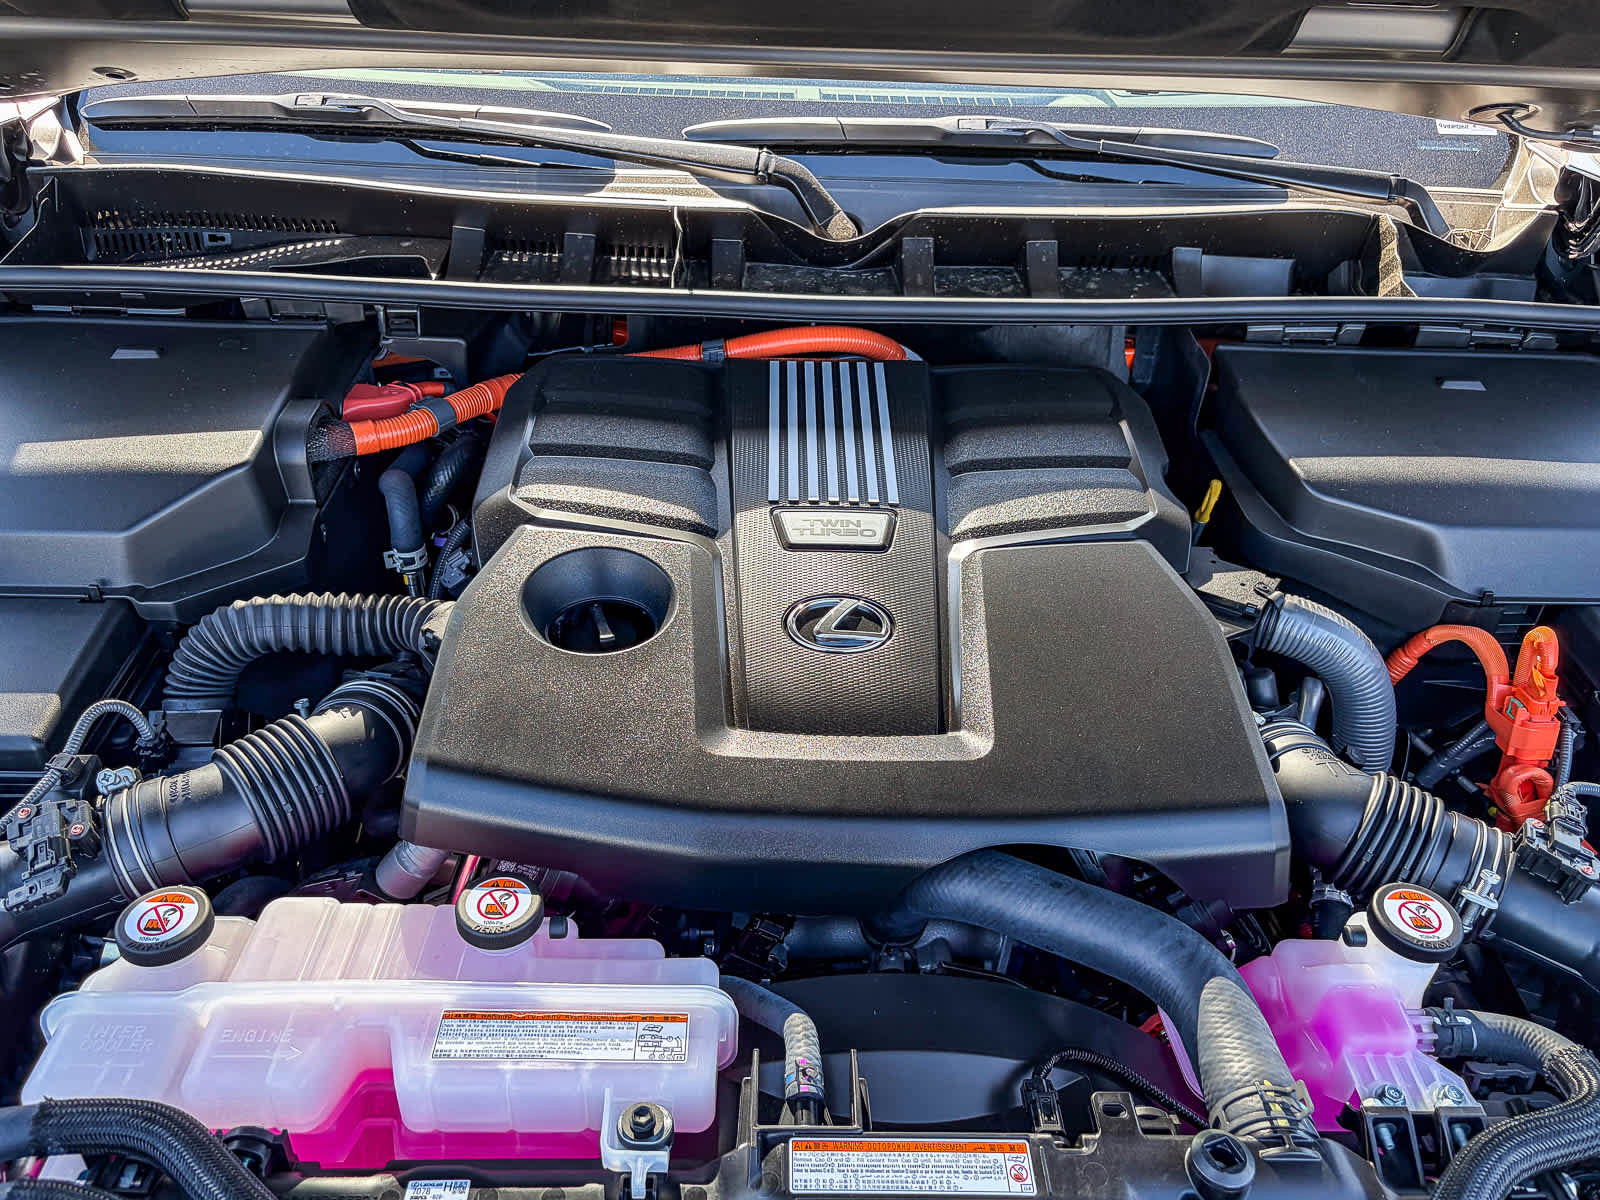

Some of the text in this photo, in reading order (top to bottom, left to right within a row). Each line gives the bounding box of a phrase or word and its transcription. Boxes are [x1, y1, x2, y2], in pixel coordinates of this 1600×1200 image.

[802, 519, 862, 528] TWIN
[791, 528, 877, 538] TURBO
[222, 1027, 295, 1043] ENGINE
[832, 1142, 864, 1151] WARNING
[914, 1143, 968, 1152] AVERTISSEMENT
